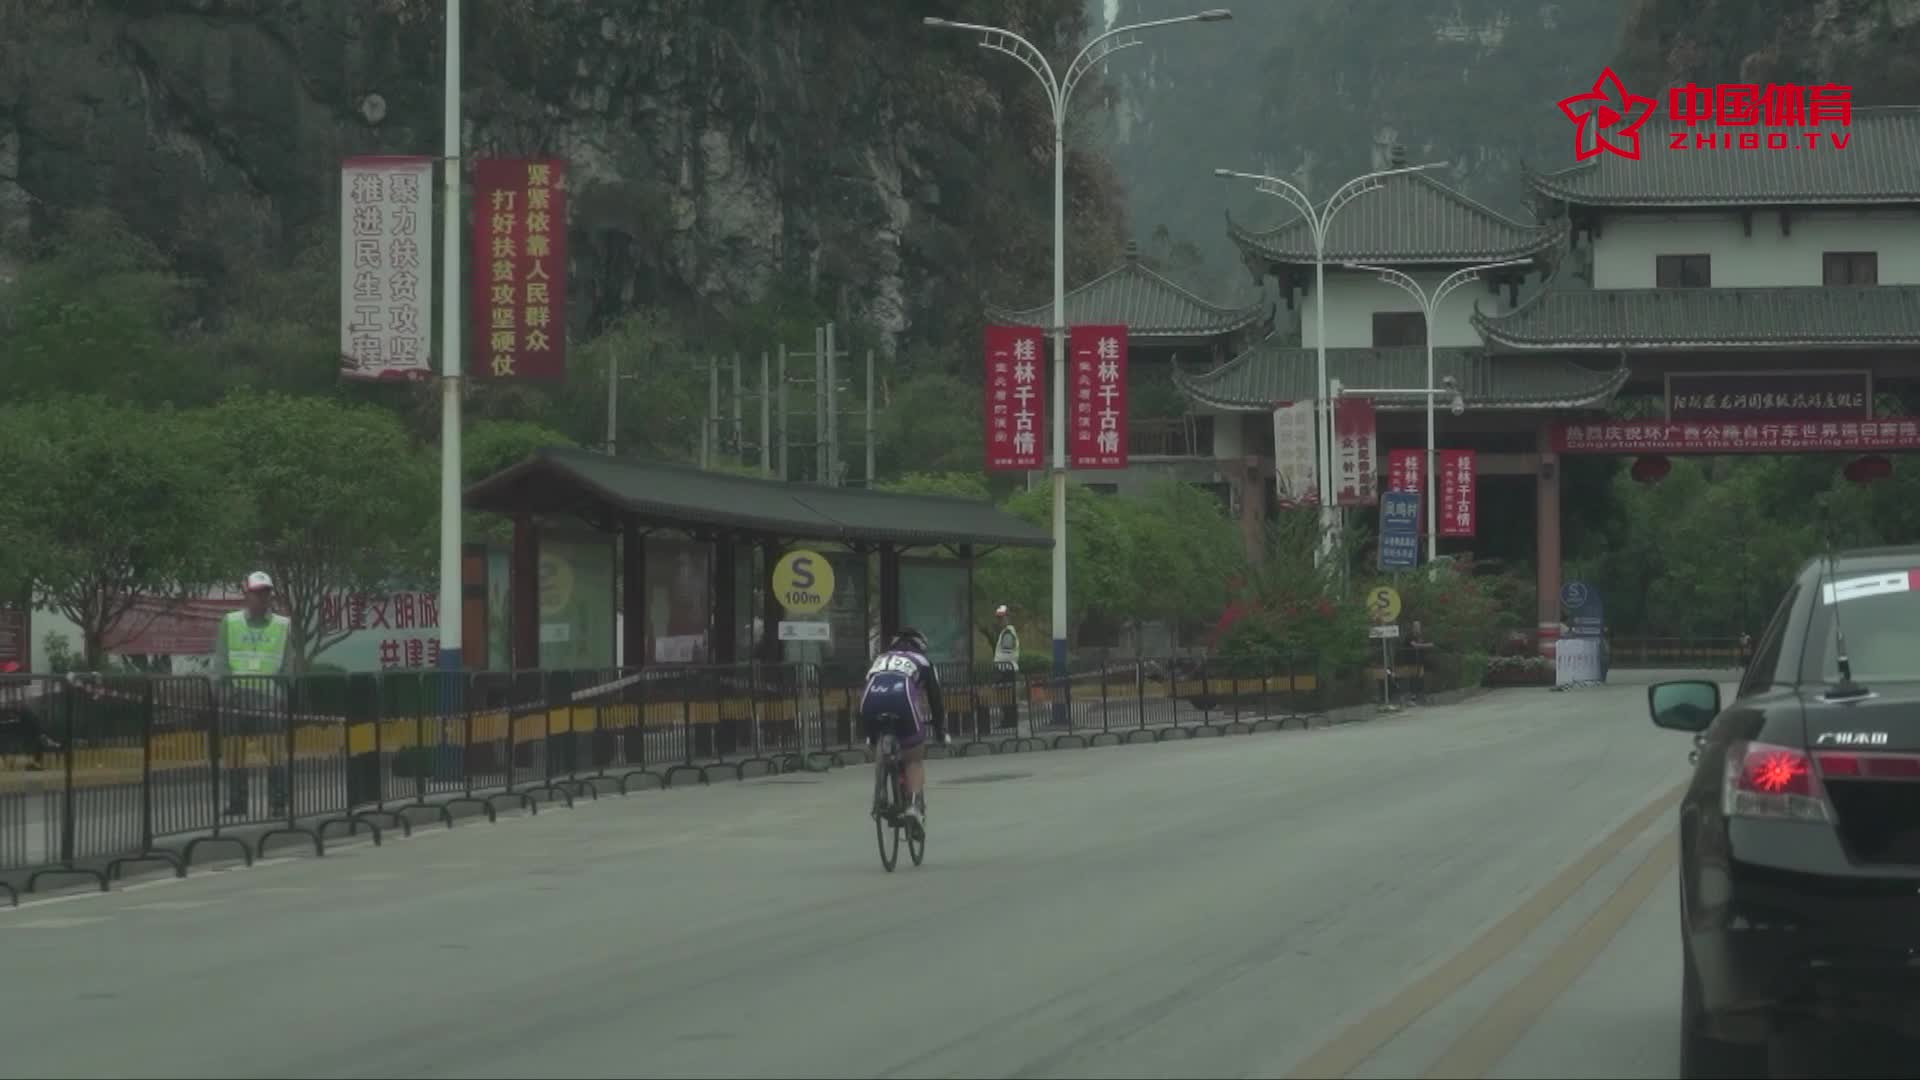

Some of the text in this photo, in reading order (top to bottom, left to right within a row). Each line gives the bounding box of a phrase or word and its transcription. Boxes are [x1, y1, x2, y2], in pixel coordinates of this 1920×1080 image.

[352, 173, 384, 370] 推进民生工程
[389, 173, 420, 366] 聚力扶贫攻坚
[490, 188, 517, 377] 打好扶贫攻坚硬仗
[525, 164, 551, 351] 紧紧依靠人民群众
[1013, 338, 1036, 455] 桂林千古情
[1097, 336, 1120, 454] 桂林千古情
[1457, 456, 1471, 527] 桂林千古情
[785, 591, 821, 605] 100m
[791, 557, 815, 588] S
[1376, 591, 1391, 608] S
[1815, 731, 1889, 745] 广州本田
